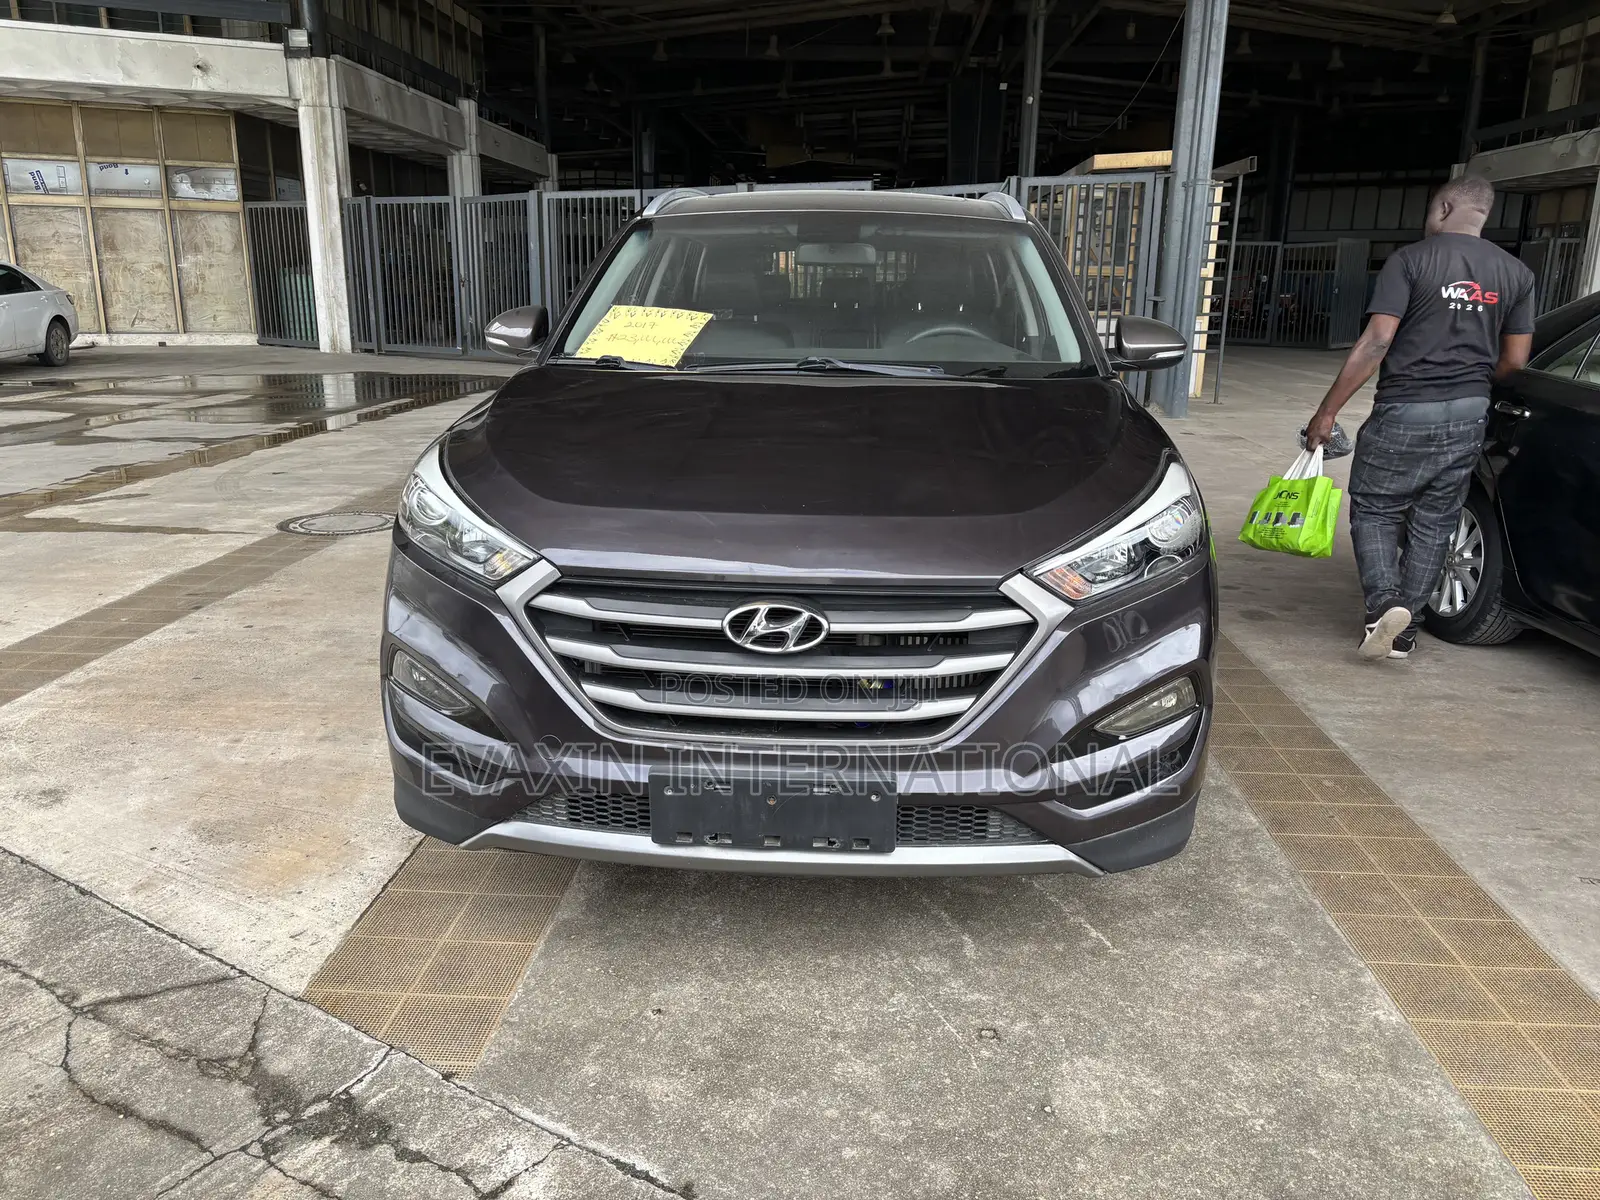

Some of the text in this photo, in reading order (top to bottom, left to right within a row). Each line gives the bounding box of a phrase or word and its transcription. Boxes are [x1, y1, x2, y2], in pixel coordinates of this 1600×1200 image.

[28, 171, 41, 191] Bond
[1441, 285, 1499, 305] WAAS
[1448, 302, 1484, 312] 2026
[623, 321, 659, 330] 2017
